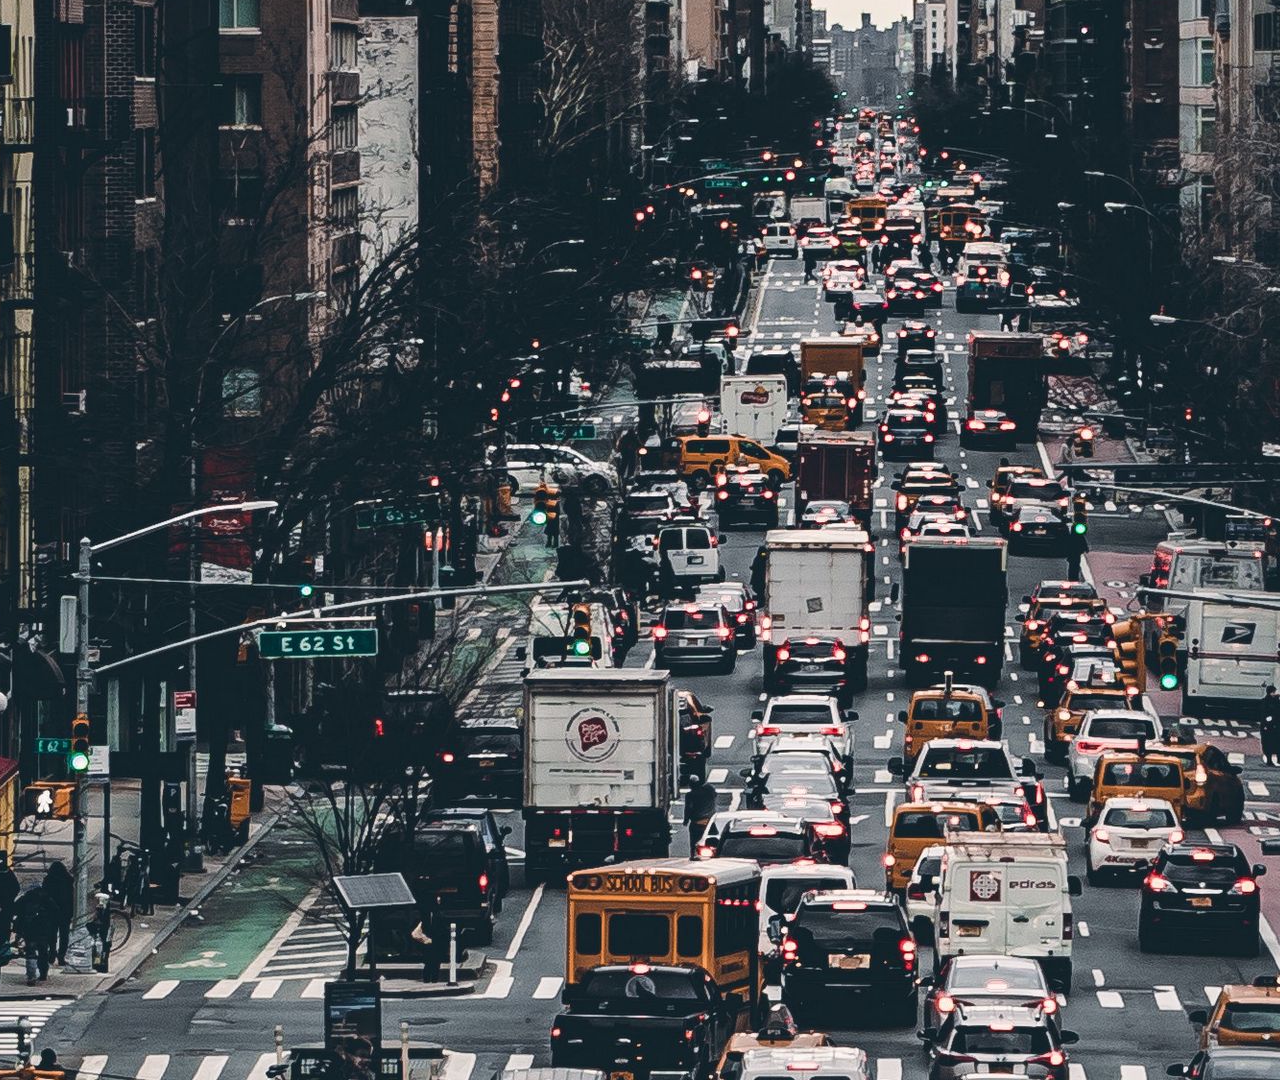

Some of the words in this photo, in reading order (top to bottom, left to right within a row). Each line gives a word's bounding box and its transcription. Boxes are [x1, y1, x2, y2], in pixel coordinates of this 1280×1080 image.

[281, 637, 293, 652] E
[299, 636, 325, 652] 62
[332, 635, 355, 651] St
[607, 874, 646, 892] SCHOOL
[650, 874, 674, 893] BUS
